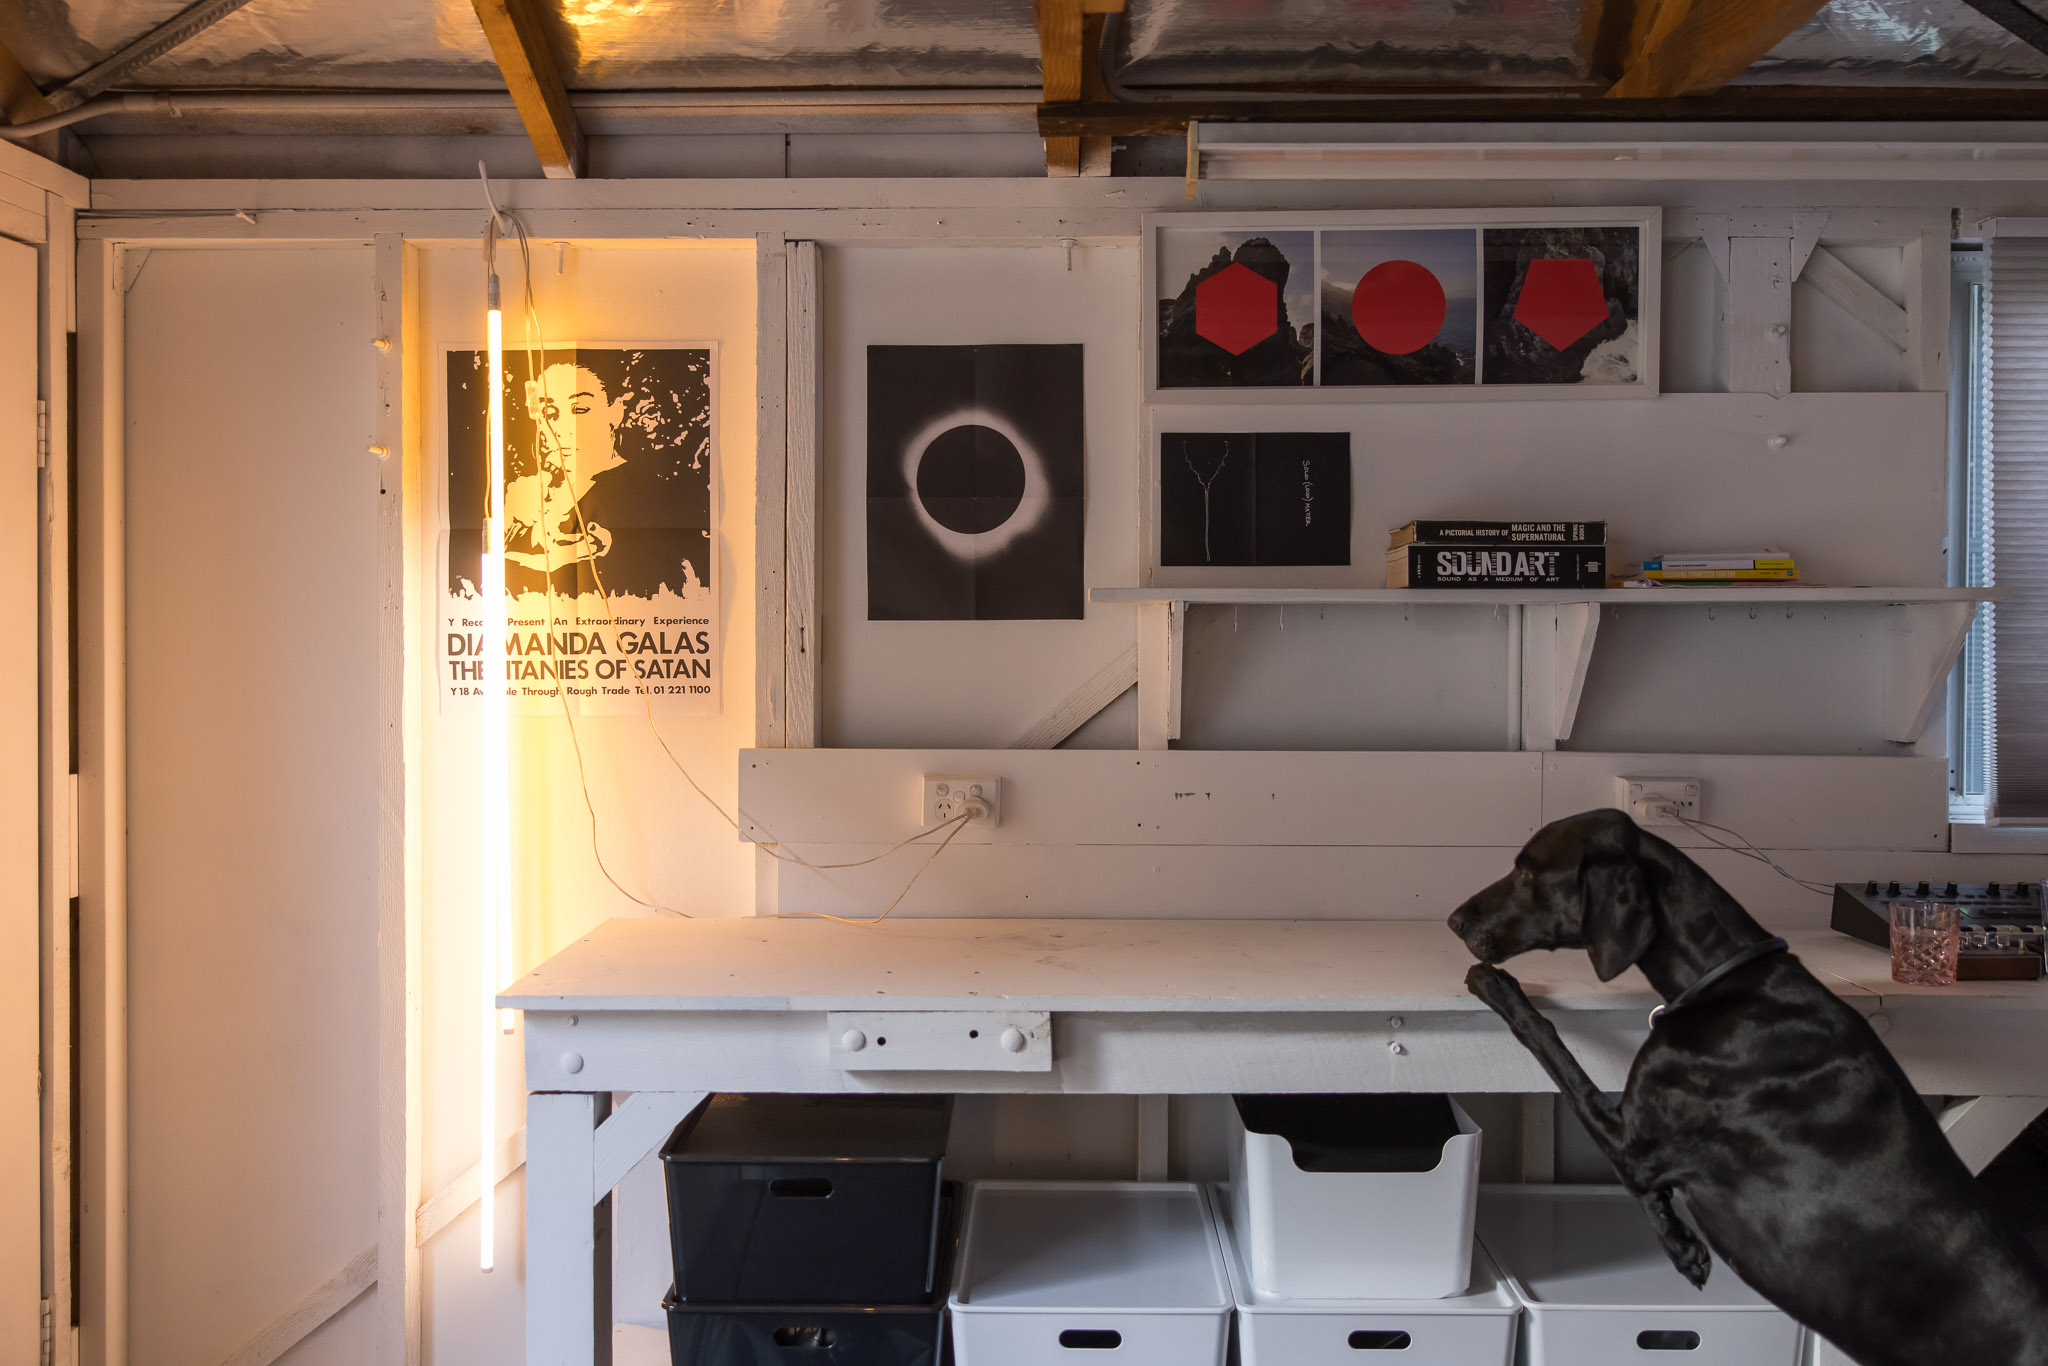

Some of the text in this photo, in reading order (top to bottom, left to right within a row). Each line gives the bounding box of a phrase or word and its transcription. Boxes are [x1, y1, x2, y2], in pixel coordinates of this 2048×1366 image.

[1511, 524, 1566, 532] MAGIC AND THE
[1511, 533, 1566, 541] SUPERNATURAL
[1437, 551, 1512, 576] SOUND
[1514, 551, 1560, 576] ART
[448, 618, 455, 627] Y
[507, 617, 545, 626] Present
[553, 617, 568, 626] An
[576, 616, 645, 627] Extraordinary
[653, 616, 710, 627] Experience
[616, 631, 710, 655] GALAS
[449, 658, 711, 680] THE ITANIES OF SATAN
[522, 687, 560, 698] Through
[567, 686, 598, 697] Rough
[602, 686, 630, 695] Trade
[653, 686, 665, 695] 01
[668, 685, 686, 694] 221
[689, 685, 711, 694] 1100
